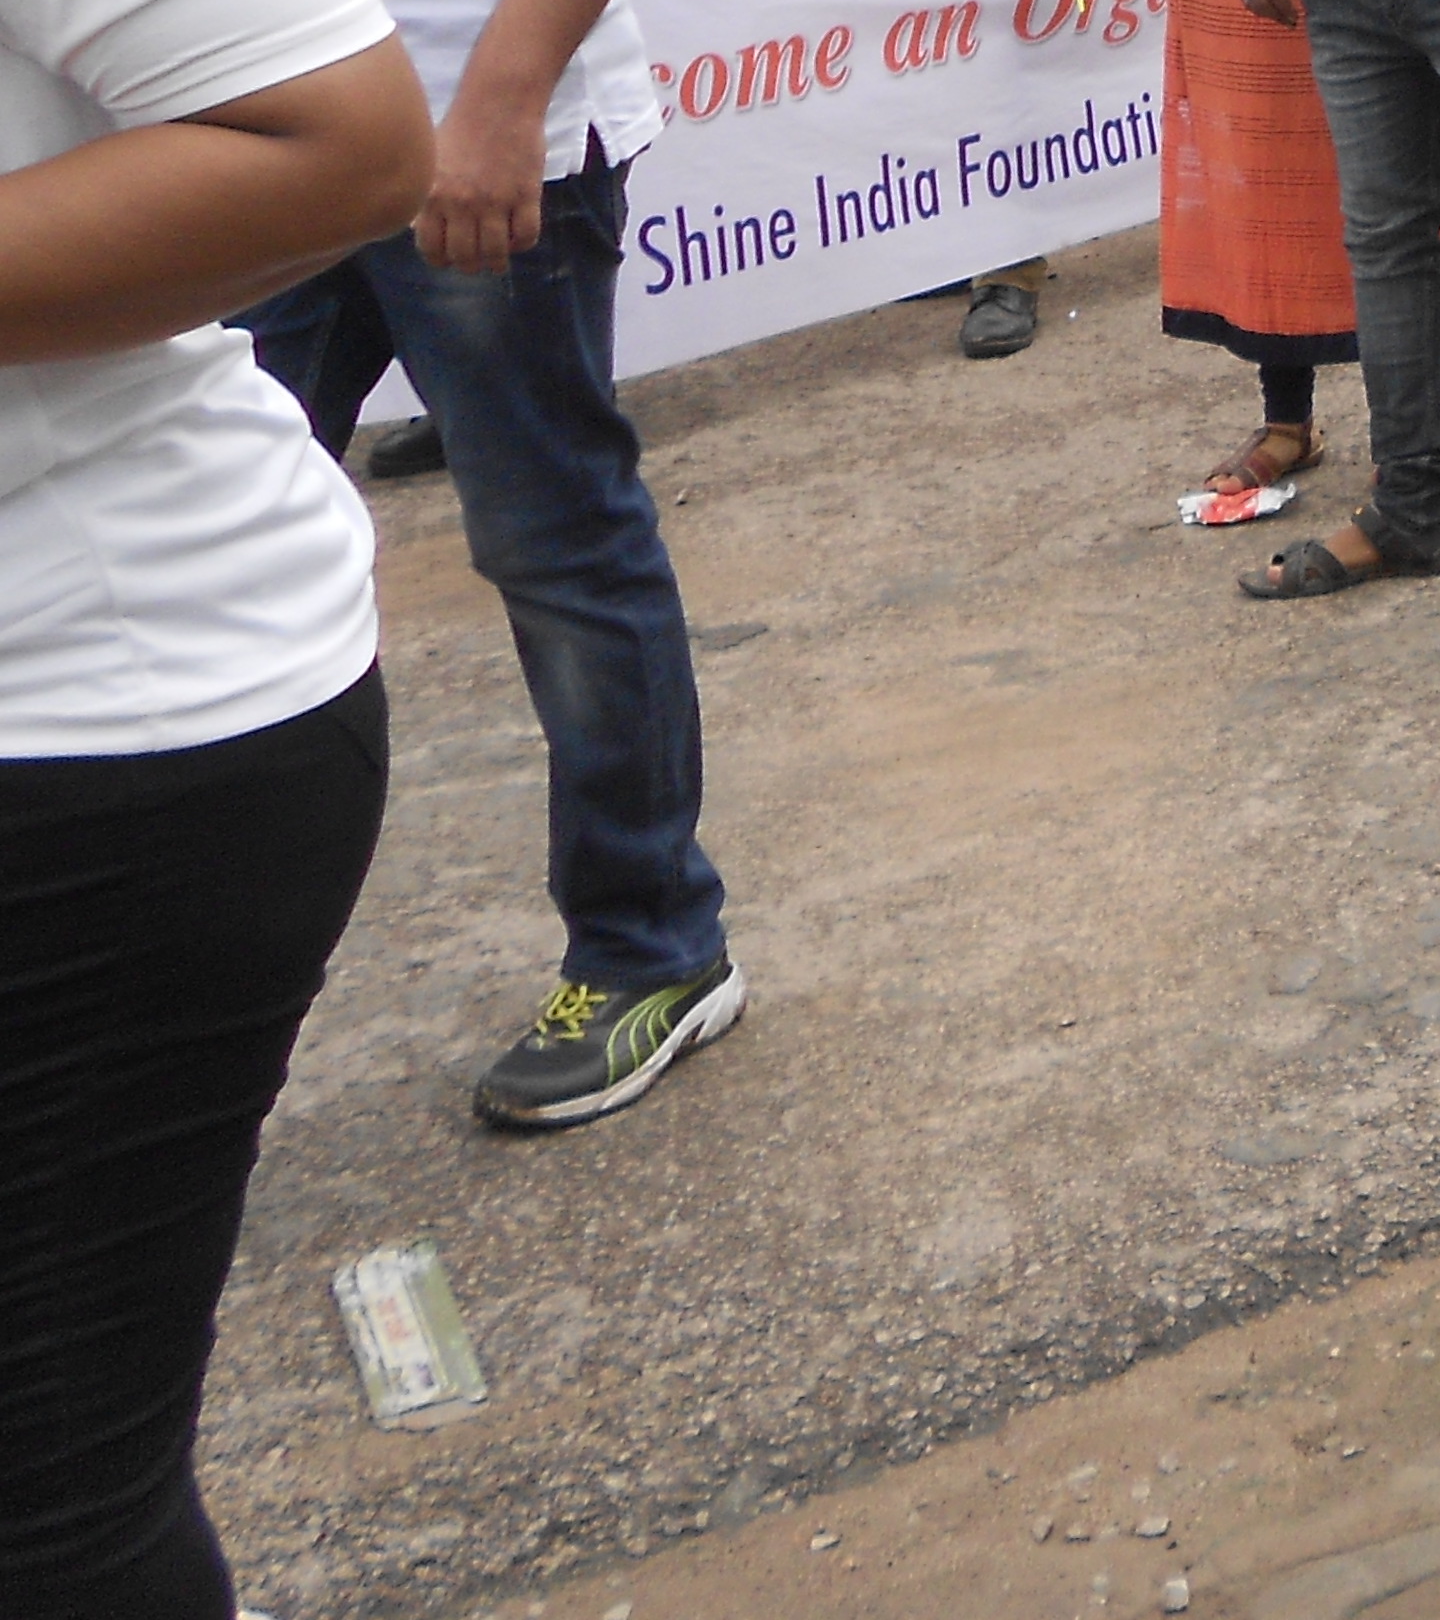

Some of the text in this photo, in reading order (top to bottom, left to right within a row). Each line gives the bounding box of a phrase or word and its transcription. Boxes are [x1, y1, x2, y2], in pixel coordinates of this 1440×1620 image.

[638, 92, 1164, 296] Shine India Foundati
